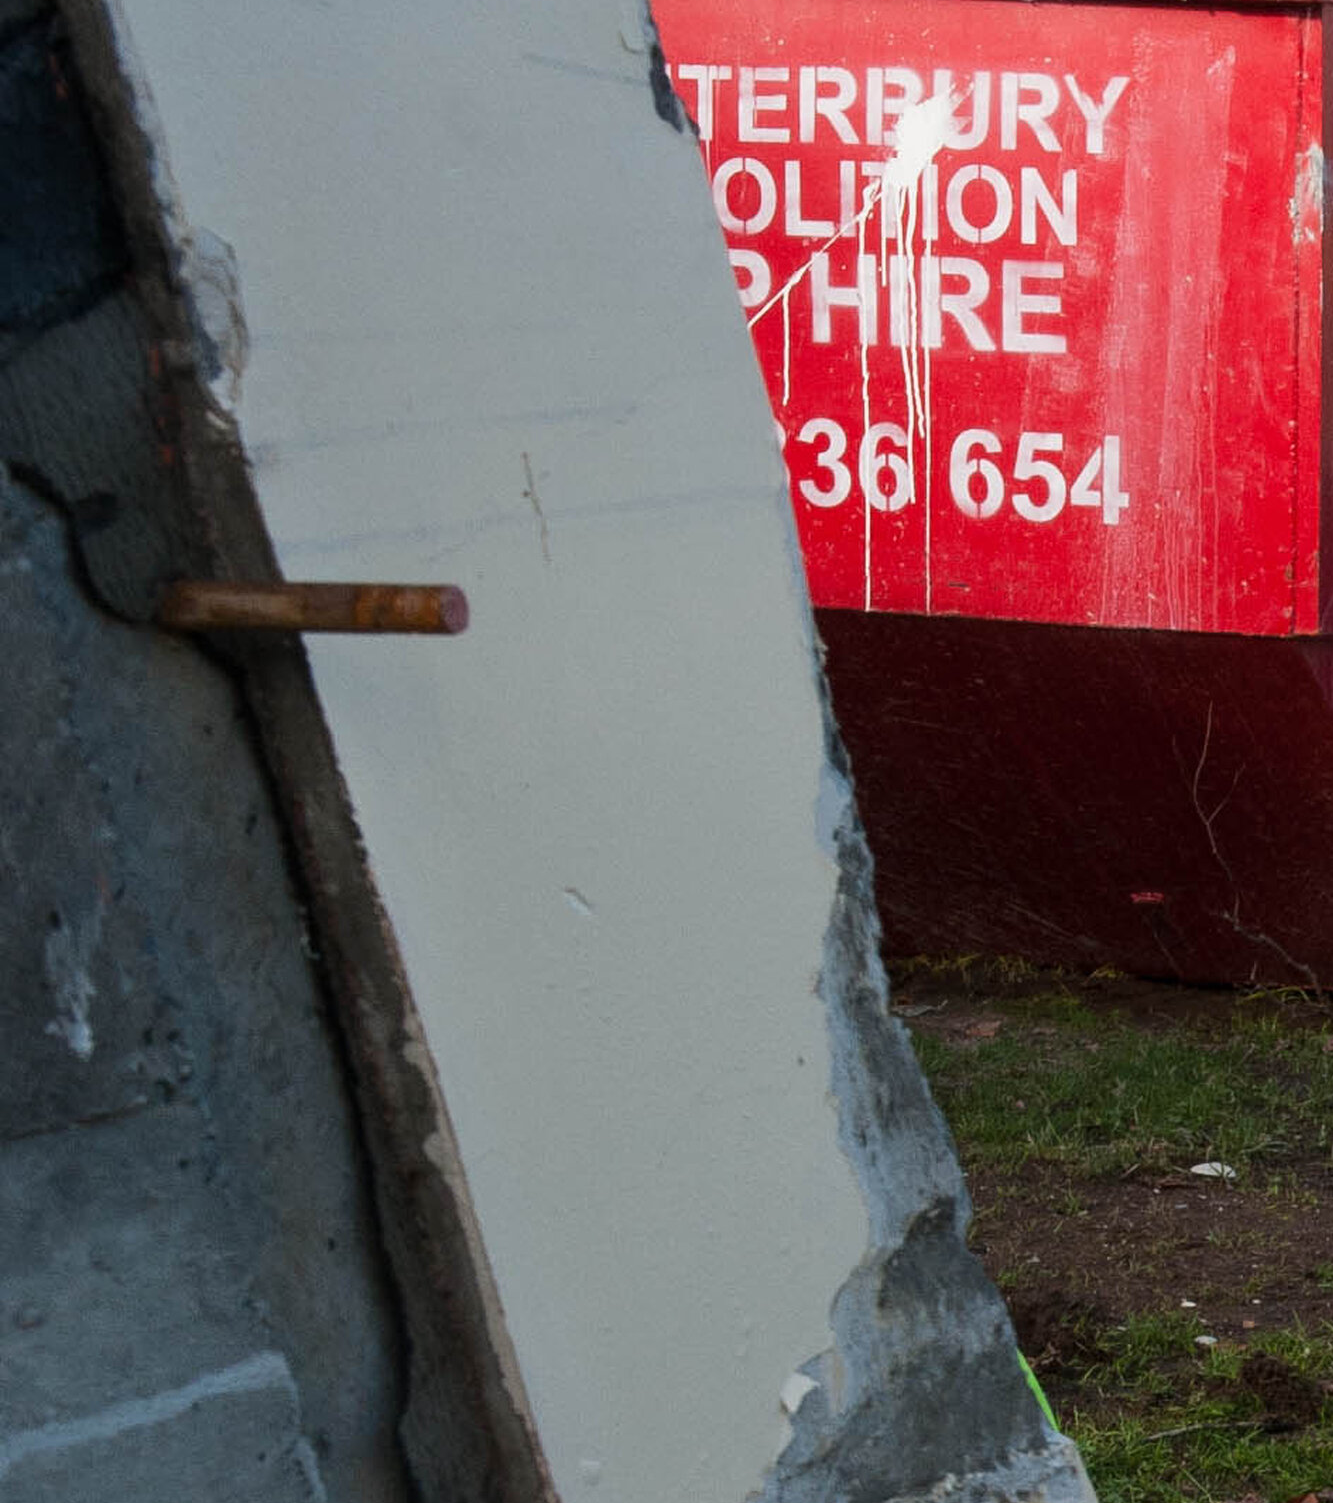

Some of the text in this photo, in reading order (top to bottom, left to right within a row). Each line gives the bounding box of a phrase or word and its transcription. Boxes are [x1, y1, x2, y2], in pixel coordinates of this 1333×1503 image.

[666, 63, 1131, 155] TERBURY
[712, 157, 1078, 246] OLITION
[810, 251, 1068, 355] HIRE
[776, 418, 1130, 526] 36 654
